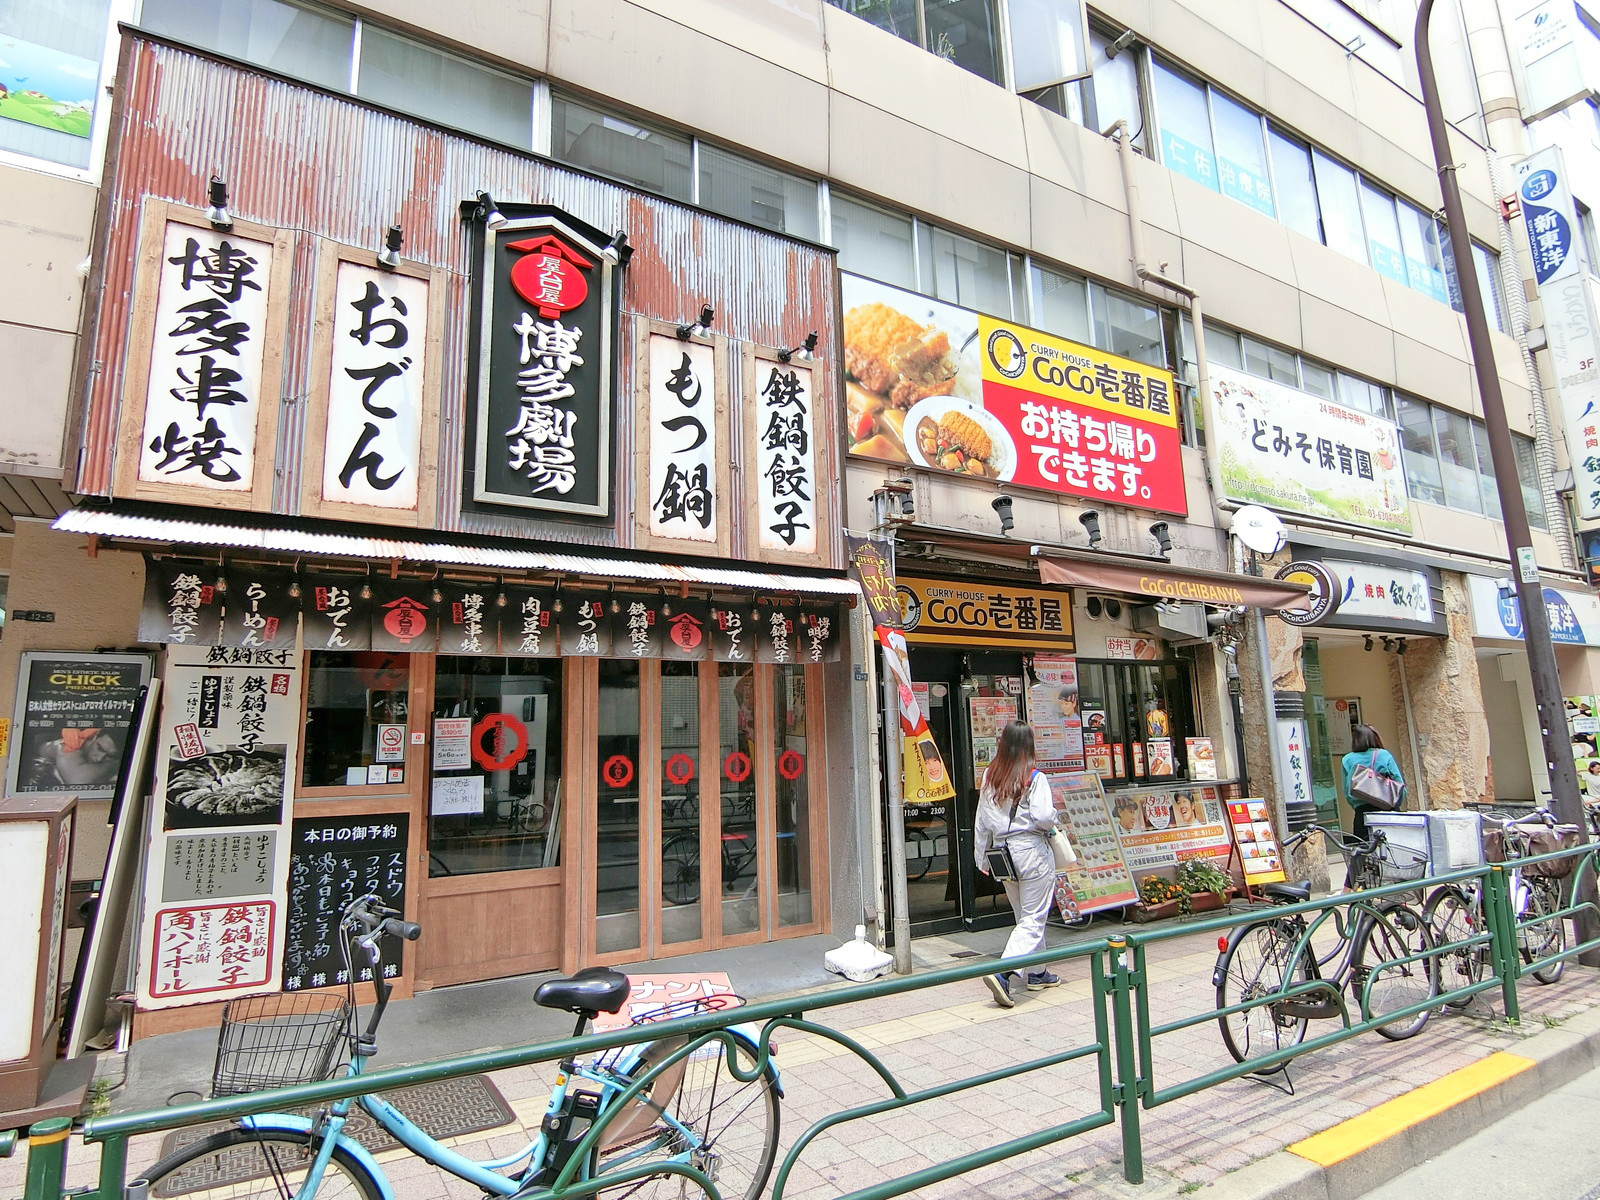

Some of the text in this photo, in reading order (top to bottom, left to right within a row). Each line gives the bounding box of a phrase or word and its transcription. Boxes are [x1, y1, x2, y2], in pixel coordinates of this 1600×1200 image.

[1533, 209, 1565, 271] 新東洋
[536, 255, 566, 308] 屋台屋
[150, 237, 262, 482] 博多串焼
[1031, 343, 1091, 369] CURRY HOUSE
[1579, 358, 1594, 370] 3F
[338, 280, 412, 491] おでん
[505, 312, 584, 496] 博多劇場
[1032, 356, 1171, 416] CoCo壱番屋
[653, 352, 713, 529] もつ鍋
[761, 367, 812, 546] 鉄鍋餃子
[1019, 401, 1156, 463] お持ち帰り
[1252, 418, 1375, 481] どみそ保育園
[1583, 425, 1599, 449] 焼肉
[1031, 444, 1151, 500] できます。
[168, 573, 203, 642] 鉄鍋餃子
[241, 583, 267, 647] らーめん
[926, 588, 985, 601] CURRY HOUSE
[927, 593, 1063, 632] CoCo壱番屋
[1139, 576, 1243, 603] CoCoICHIBANYA
[1364, 583, 1386, 599] 焼肉
[326, 586, 352, 648] おでん
[461, 594, 485, 653] 博多串焼
[518, 596, 541, 654] 肉豆腐
[576, 600, 599, 653] もつ鍋
[626, 602, 650, 656] 鉄鍋餃子
[726, 610, 744, 660] おでん
[769, 612, 790, 663] 鉄鍋餃子
[1546, 602, 1575, 633] 東洋
[807, 627, 823, 662] 明太子
[1107, 639, 1131, 651] お弁当
[1108, 650, 1132, 658] コーナー
[49, 674, 122, 685] CHICK
[202, 678, 219, 726] ゆずこしょう
[236, 676, 268, 752] 鉄鍋餃子
[304, 824, 397, 843] 本日の御予約
[930, 807, 946, 815] 23:00
[255, 835, 269, 884] ゆずこしょう
[366, 856, 380, 895] フジタ
[387, 852, 403, 897] スドウ
[161, 910, 196, 992] 角ハイボール
[194, 912, 213, 964] 旨さに感謝
[216, 906, 254, 985] 鉄鍋餃子
[251, 907, 268, 958] 旨さに感動
[287, 975, 302, 990] 様
[312, 973, 327, 986] 様
[384, 964, 397, 977] 様
[629, 979, 731, 1000] ナント
